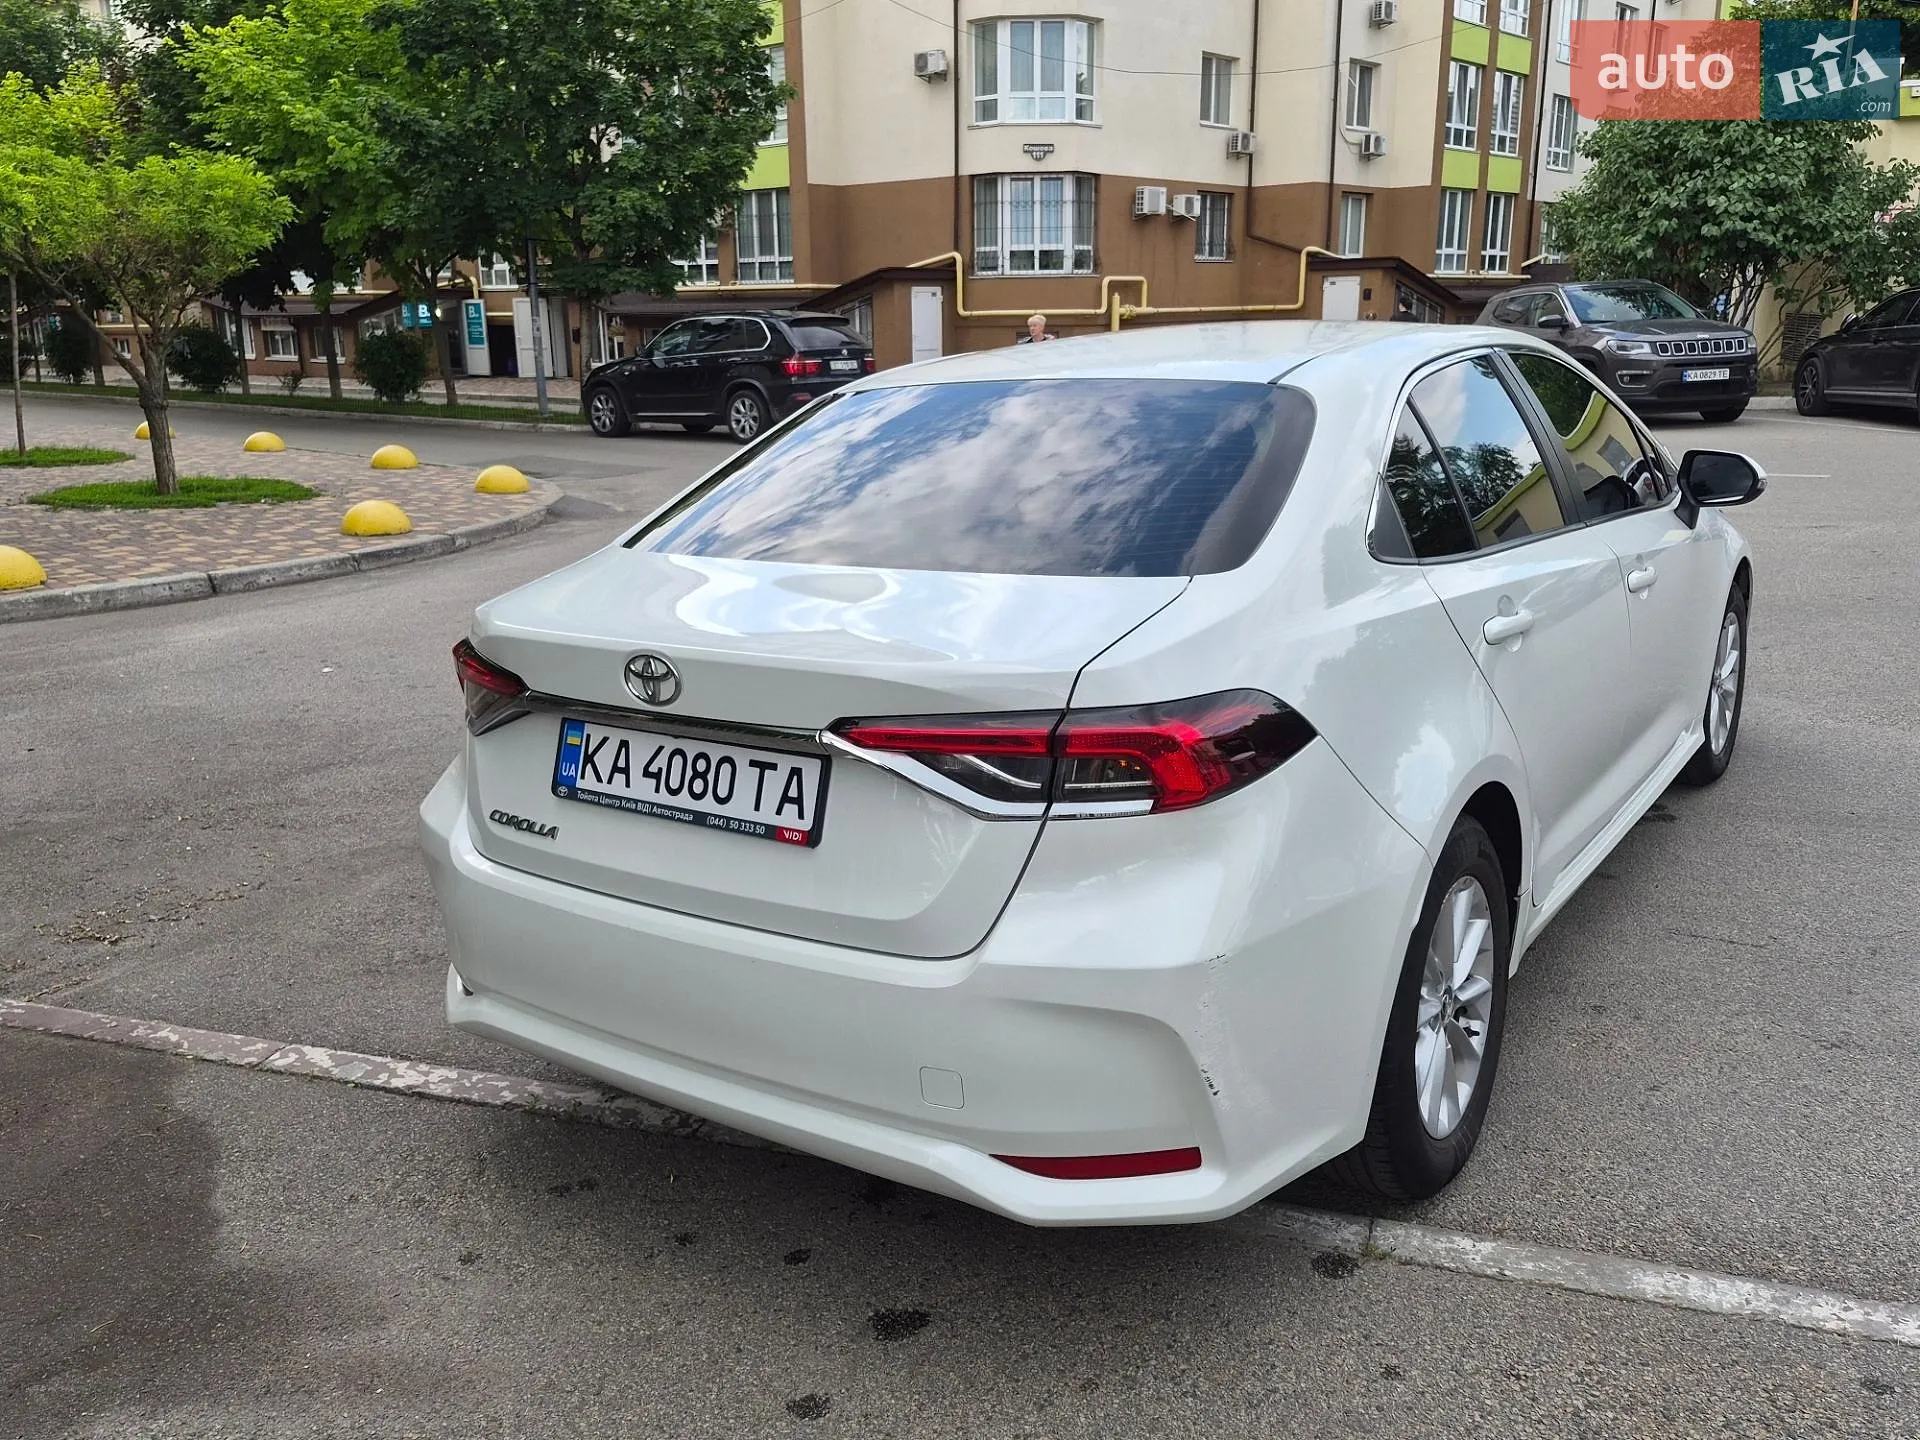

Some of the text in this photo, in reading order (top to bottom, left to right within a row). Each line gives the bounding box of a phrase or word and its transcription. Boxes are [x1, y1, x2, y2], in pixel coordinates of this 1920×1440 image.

[561, 762, 576, 778] UA
[580, 733, 805, 821] KA 4080 TA
[600, 796, 620, 807] Центр
[652, 806, 694, 821] Автострада
[489, 809, 560, 841] COROLLA
[706, 815, 766, 835] (044) 50 333 50
[783, 829, 802, 841] VIDI
